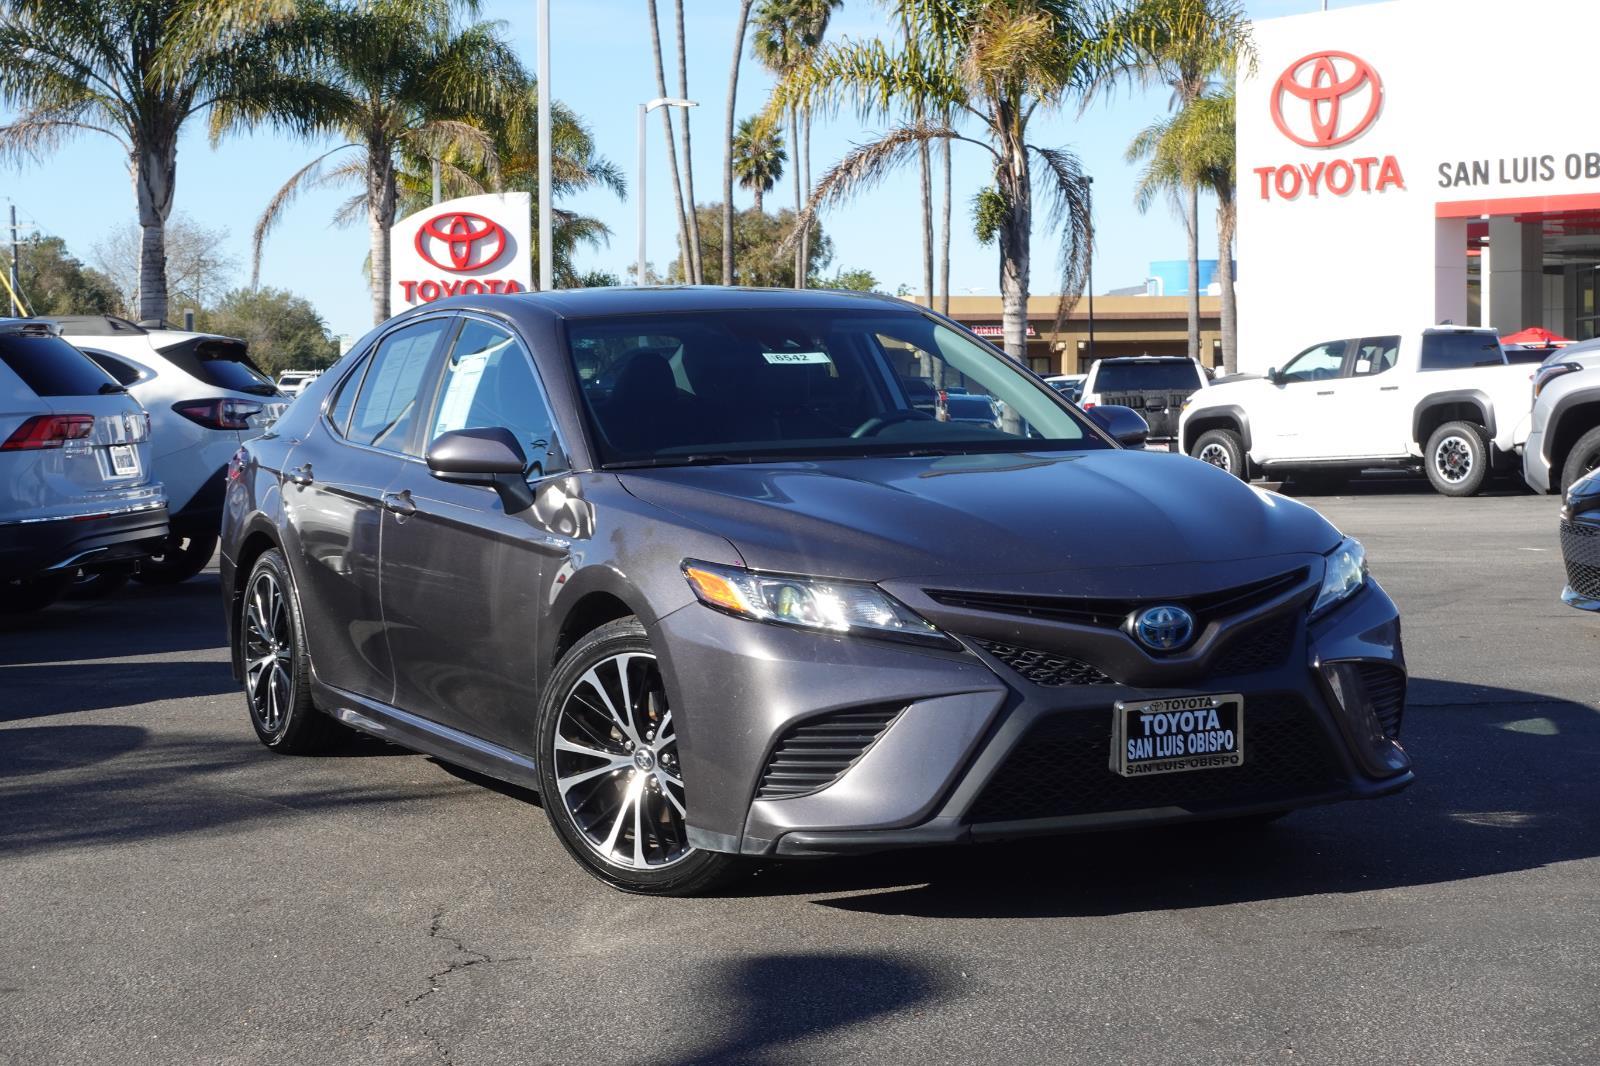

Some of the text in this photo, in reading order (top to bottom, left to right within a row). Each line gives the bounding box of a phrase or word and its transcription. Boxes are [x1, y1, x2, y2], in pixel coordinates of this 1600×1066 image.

[1253, 155, 1406, 200] TOYOTA
[1438, 160, 1489, 188] SAN
[1500, 154, 1555, 184] LUIS
[1163, 696, 1214, 711] TOYOTA
[1140, 709, 1221, 736] TOYOTA
[1127, 729, 1234, 760] SAN LUIS OBISPO
[1126, 754, 1240, 775] SAN LUIS OBISPO
